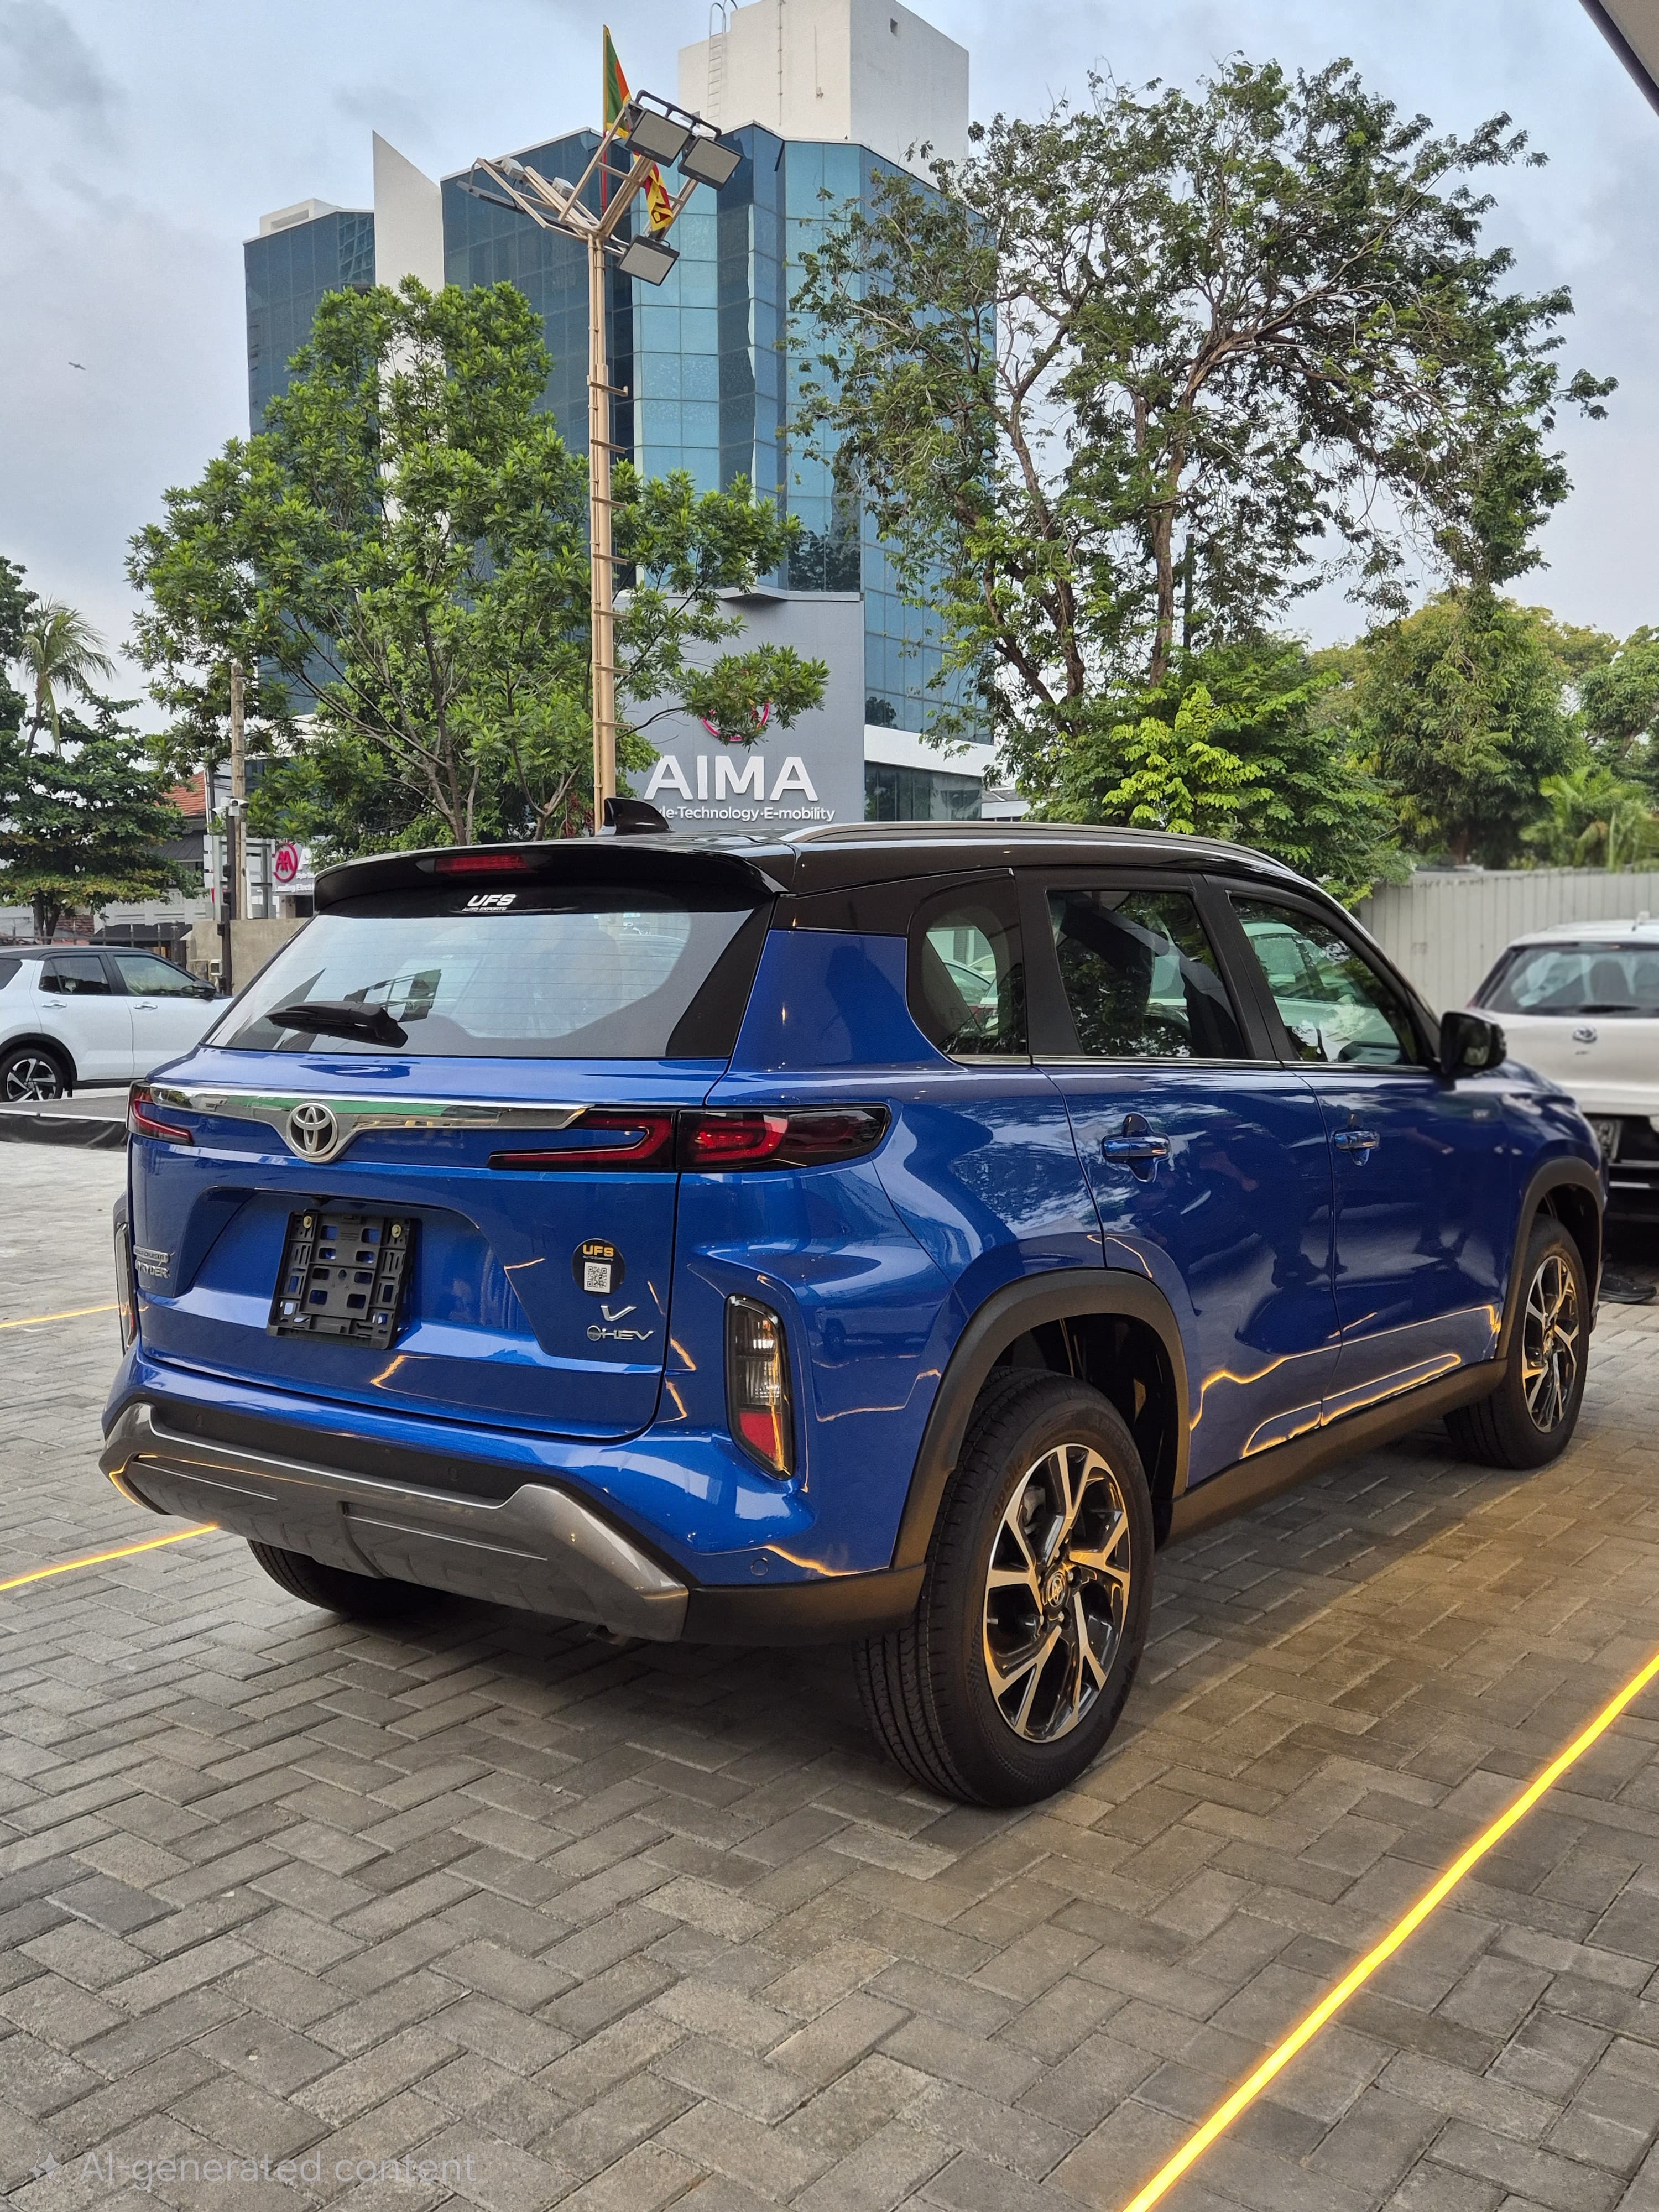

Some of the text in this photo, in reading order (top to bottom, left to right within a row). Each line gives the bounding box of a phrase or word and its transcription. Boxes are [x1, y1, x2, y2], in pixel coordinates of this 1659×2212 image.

[643, 755, 818, 802] AIMA
[467, 894, 517, 907] UFS
[582, 1244, 614, 1258] UFS
[600, 1305, 637, 1322] V
